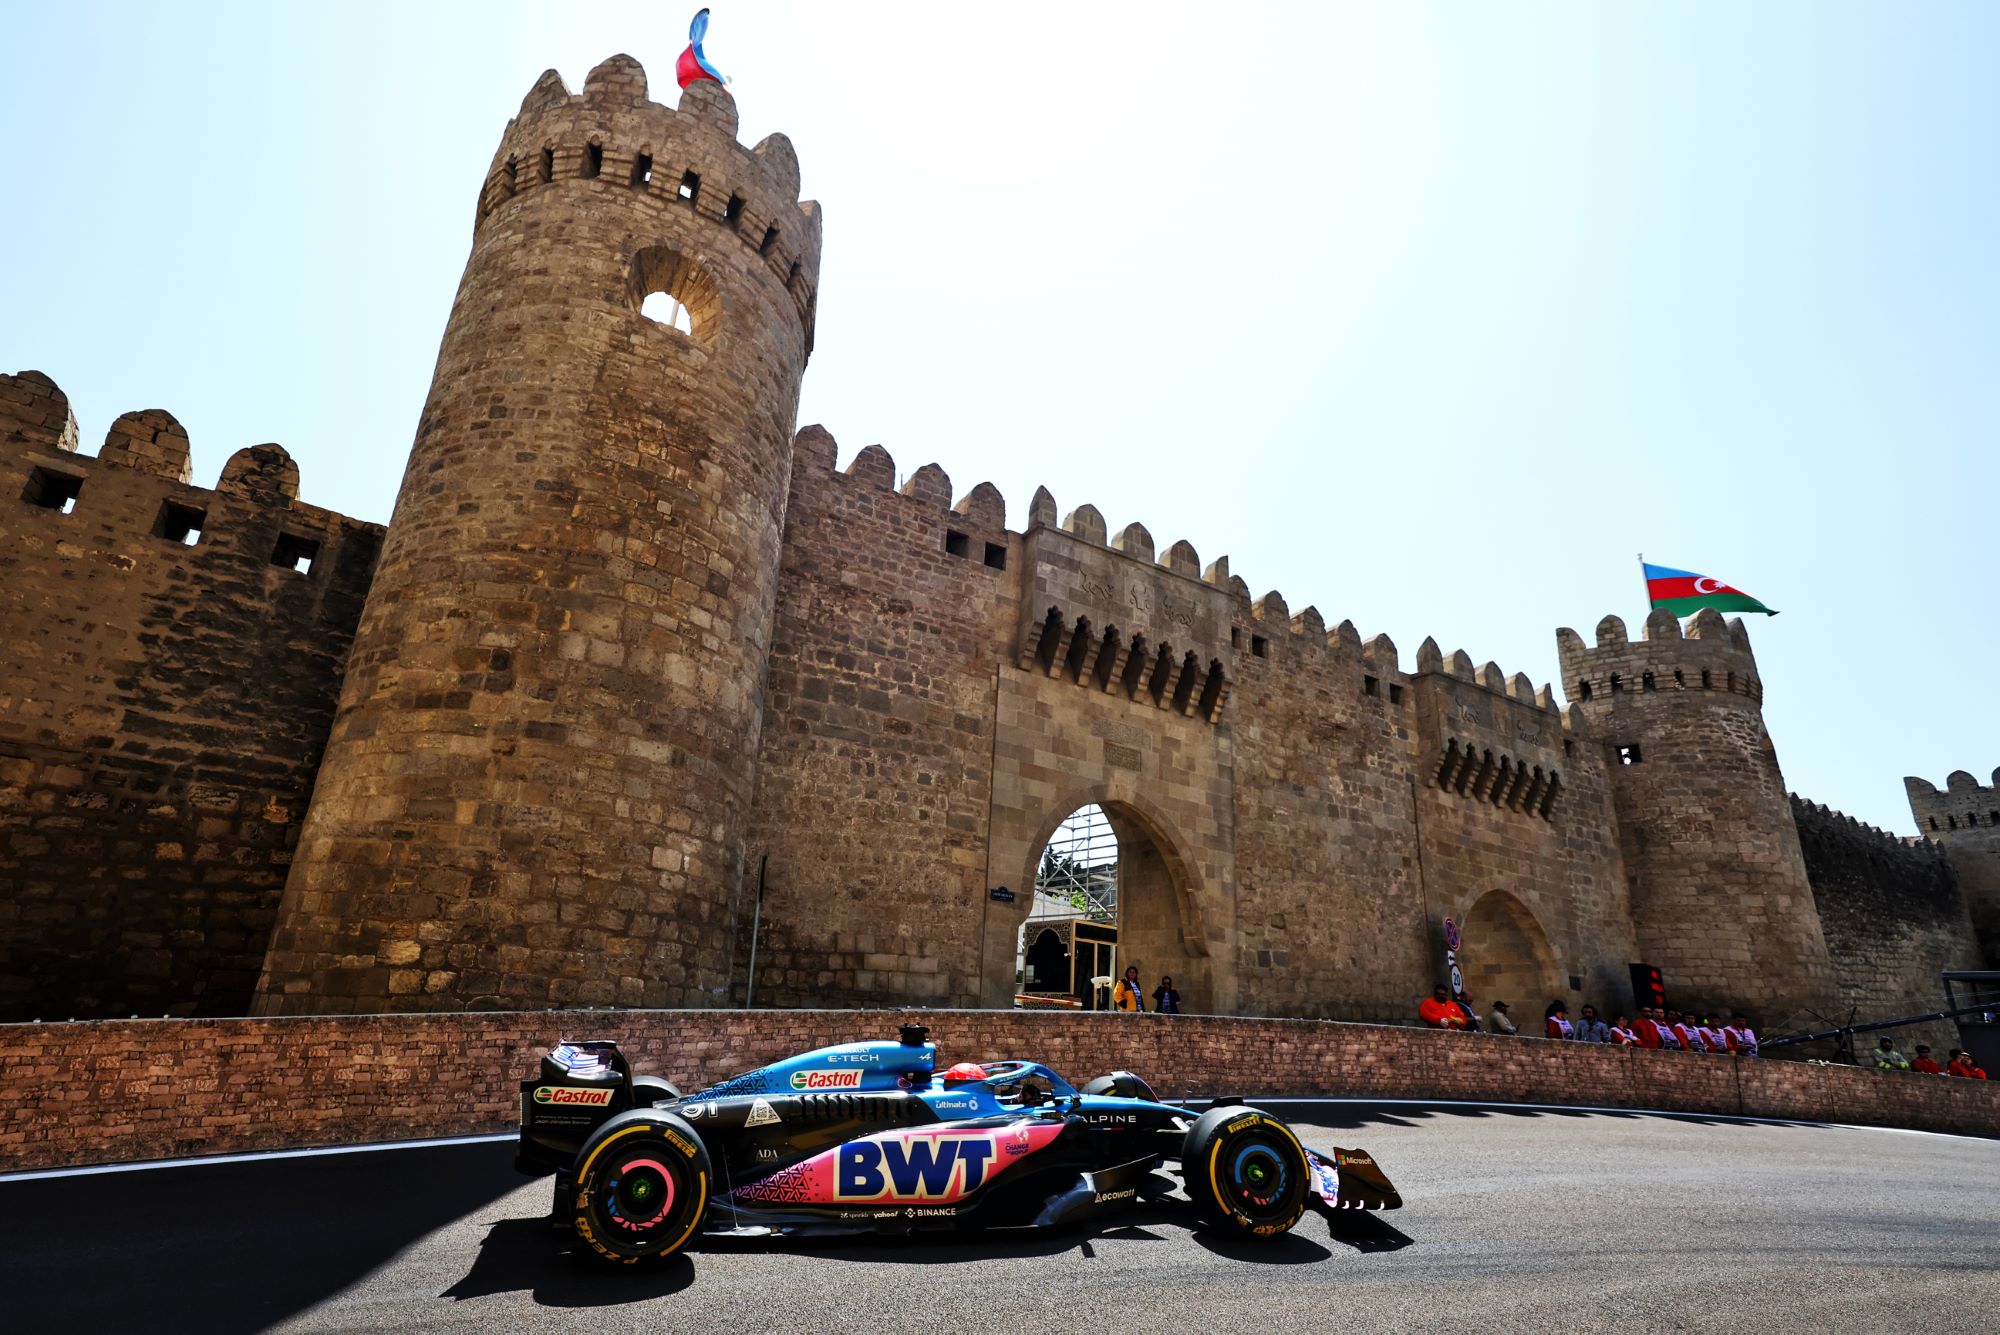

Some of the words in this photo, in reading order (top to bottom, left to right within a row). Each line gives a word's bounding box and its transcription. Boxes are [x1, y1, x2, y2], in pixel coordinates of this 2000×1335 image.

[1453, 972, 1461, 986] 20
[828, 1054, 879, 1063] E-TECH
[808, 1071, 859, 1088] Castrol
[552, 1088, 608, 1104] Castrol
[1081, 1115, 1137, 1123] ALPINE
[1227, 1113, 1261, 1134] PIRELLI
[757, 1149, 778, 1158] ADA
[1346, 1156, 1372, 1165] Microsoft
[838, 1139, 992, 1197] BWT
[1102, 1188, 1135, 1201] ecowatt
[873, 1205, 898, 1219] yahoo!
[917, 1203, 956, 1217] BINANCE
